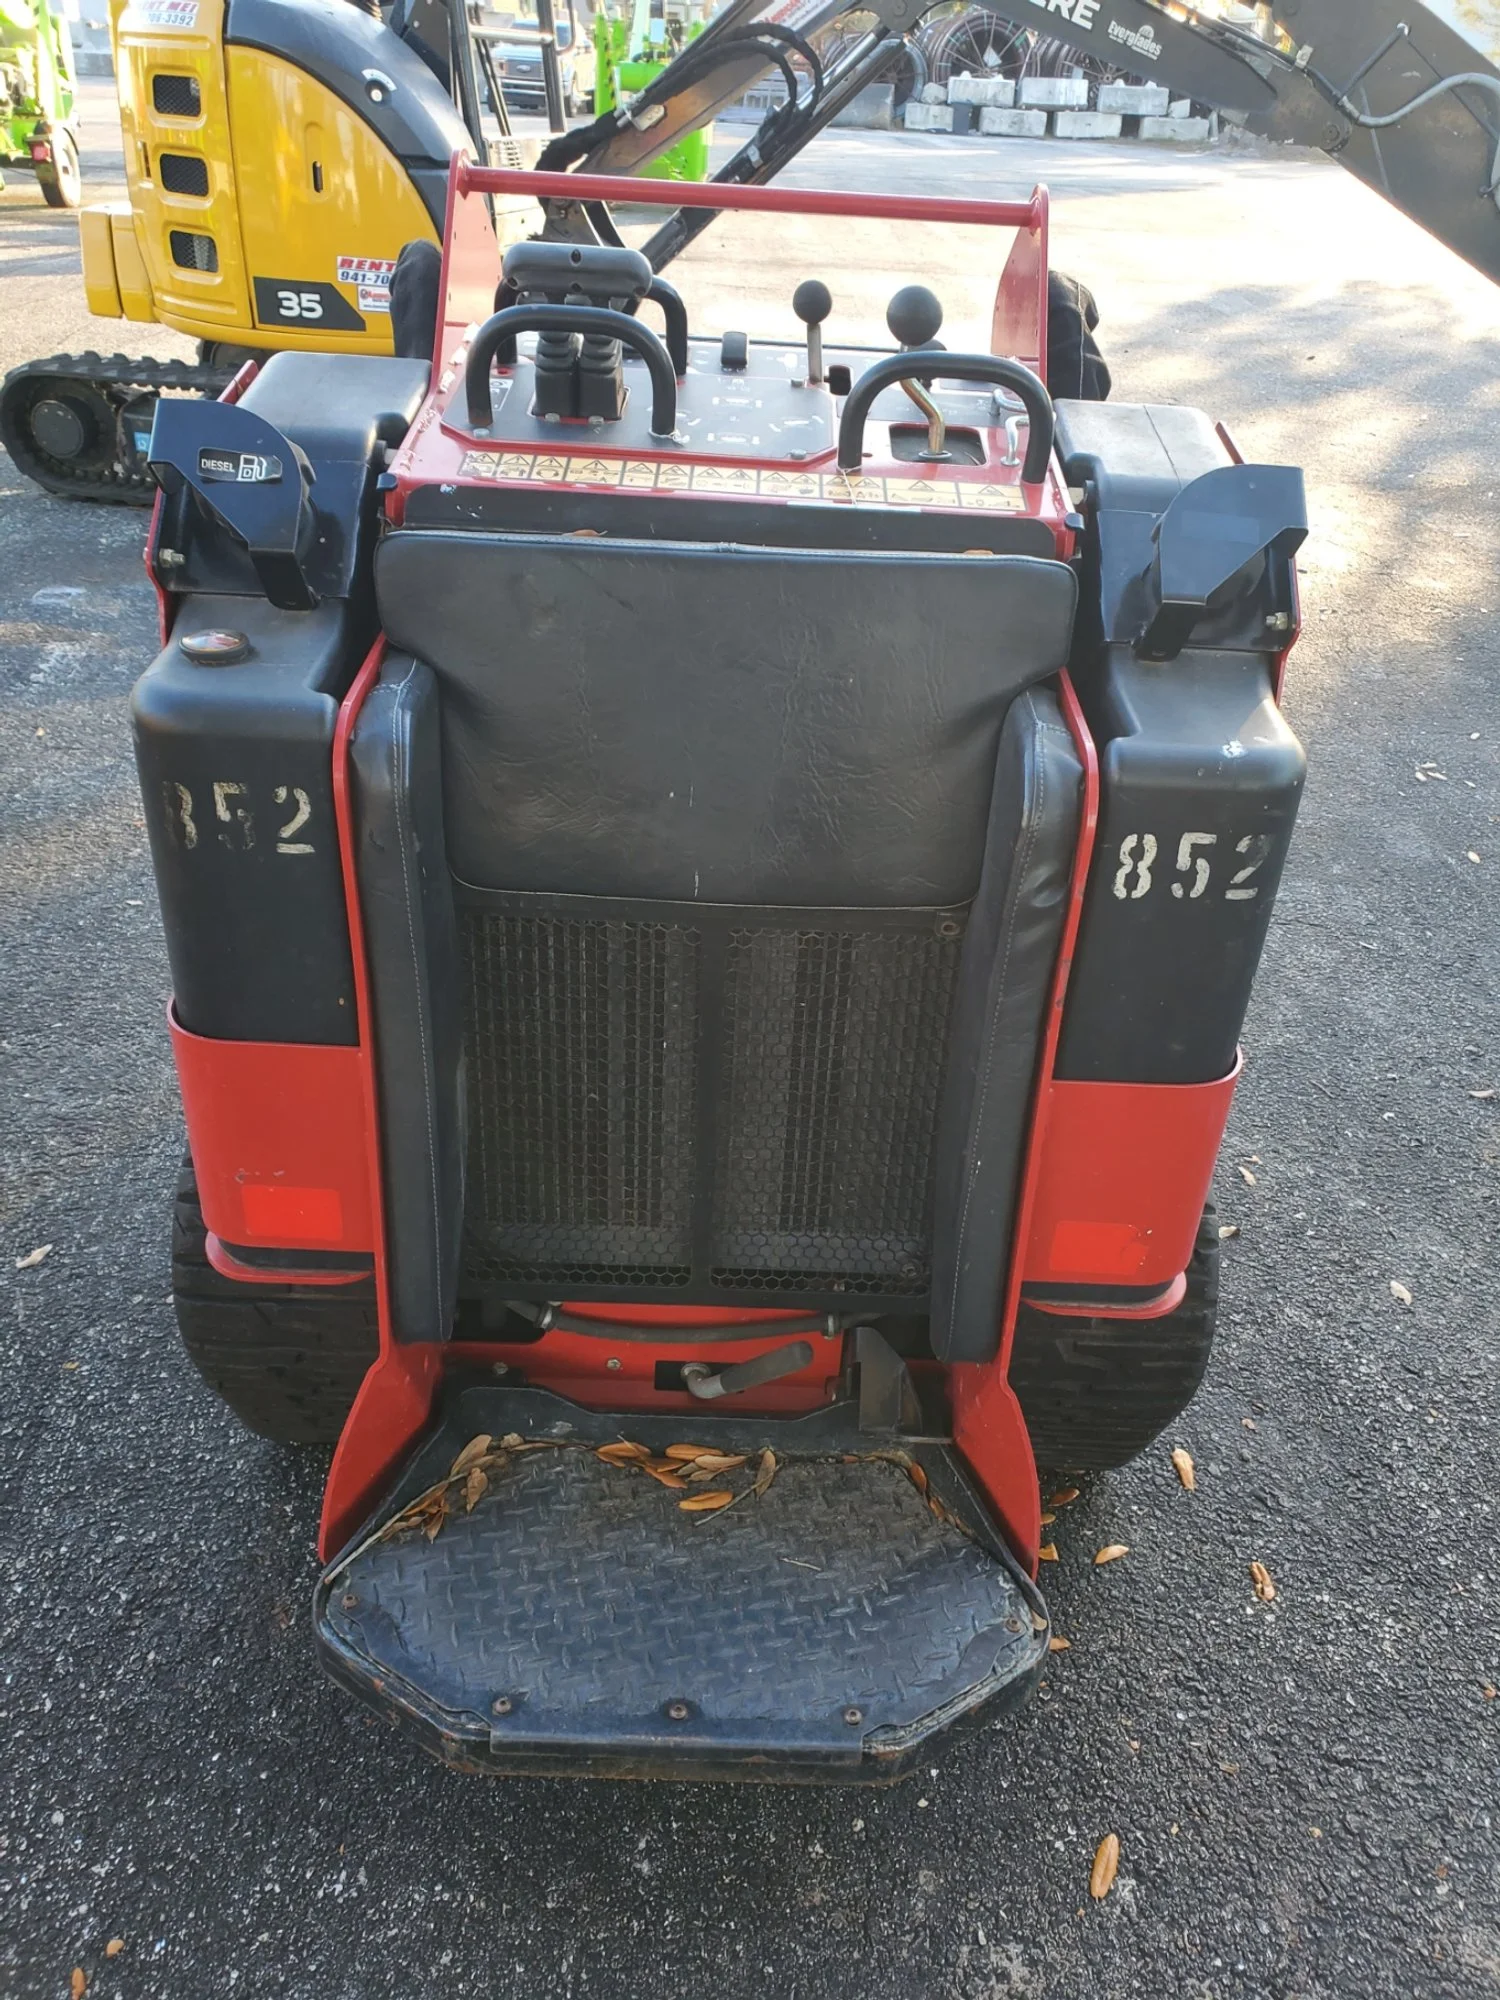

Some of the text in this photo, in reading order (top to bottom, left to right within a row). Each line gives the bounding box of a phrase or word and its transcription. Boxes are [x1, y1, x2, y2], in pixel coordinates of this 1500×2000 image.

[1107, 20, 1162, 56] Everglades
[340, 258, 397, 272] RENT
[340, 270, 390, 285] 941-70
[277, 291, 323, 319] 35
[201, 458, 252, 478] DIESEL D
[1112, 832, 1271, 900] 852
